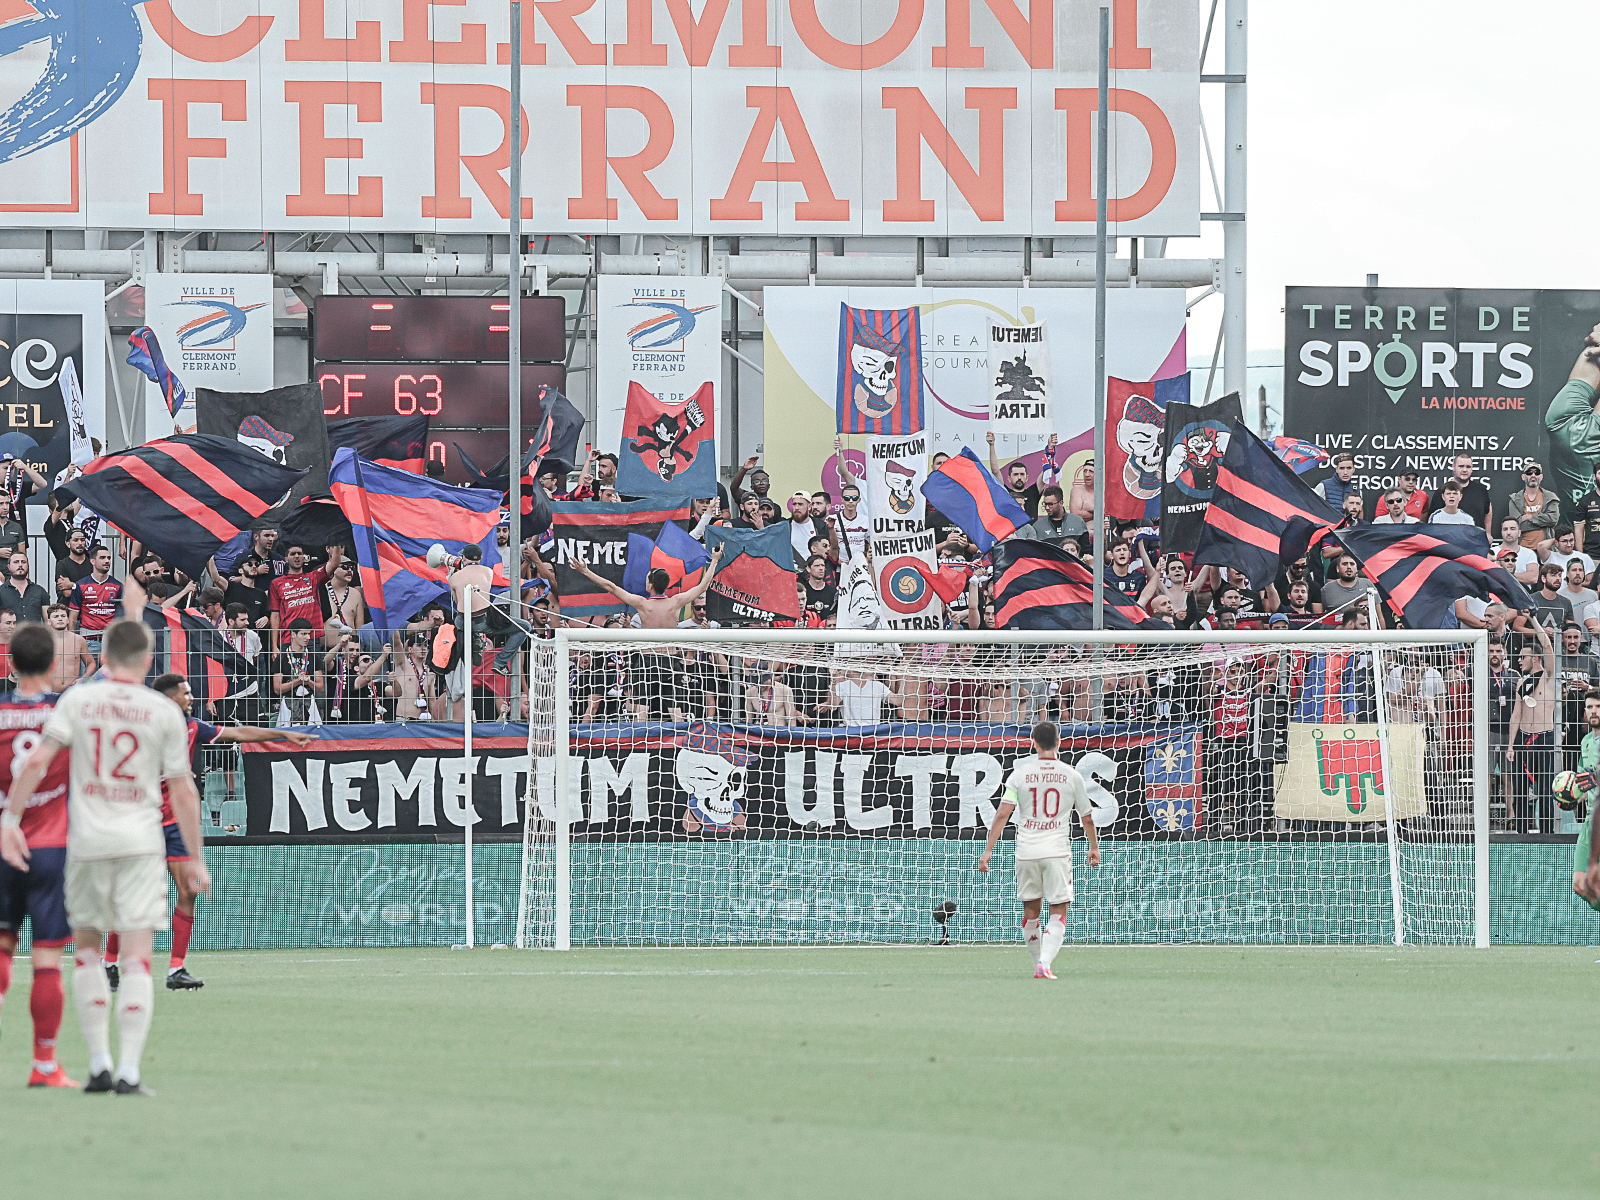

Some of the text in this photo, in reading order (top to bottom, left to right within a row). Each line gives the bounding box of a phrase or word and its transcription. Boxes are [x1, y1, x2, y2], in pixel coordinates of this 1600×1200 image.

[148, 78, 1177, 222] FERRAND
[182, 287, 235, 295] VILLE DE
[633, 288, 686, 297] VILLE DE
[1302, 304, 1531, 332] TERRE DE
[182, 352, 236, 361] CLERMONT
[632, 353, 686, 363] CLERMONT
[1297, 337, 1534, 391] SPORTS
[182, 362, 237, 371] FERRAND
[632, 363, 686, 372] FERRAND
[318, 373, 443, 416] CF 63
[1421, 396, 1526, 411] LA MONTAGNE
[872, 438, 926, 460] NEMETUM
[1315, 433, 1353, 449] LIVE
[1371, 434, 1500, 451] CLASSEMENTS
[1167, 501, 1210, 514] NEMETUM
[873, 516, 925, 534] ULTRA
[873, 533, 934, 557] NEMETUM
[710, 579, 760, 606] NEMETUM
[732, 602, 776, 622] ULTRAS
[90, 727, 139, 781] 12
[1025, 773, 1068, 785] BEN YEDDER
[269, 750, 1119, 833] NEMETUM ULTRS
[1029, 787, 1061, 818] 10
